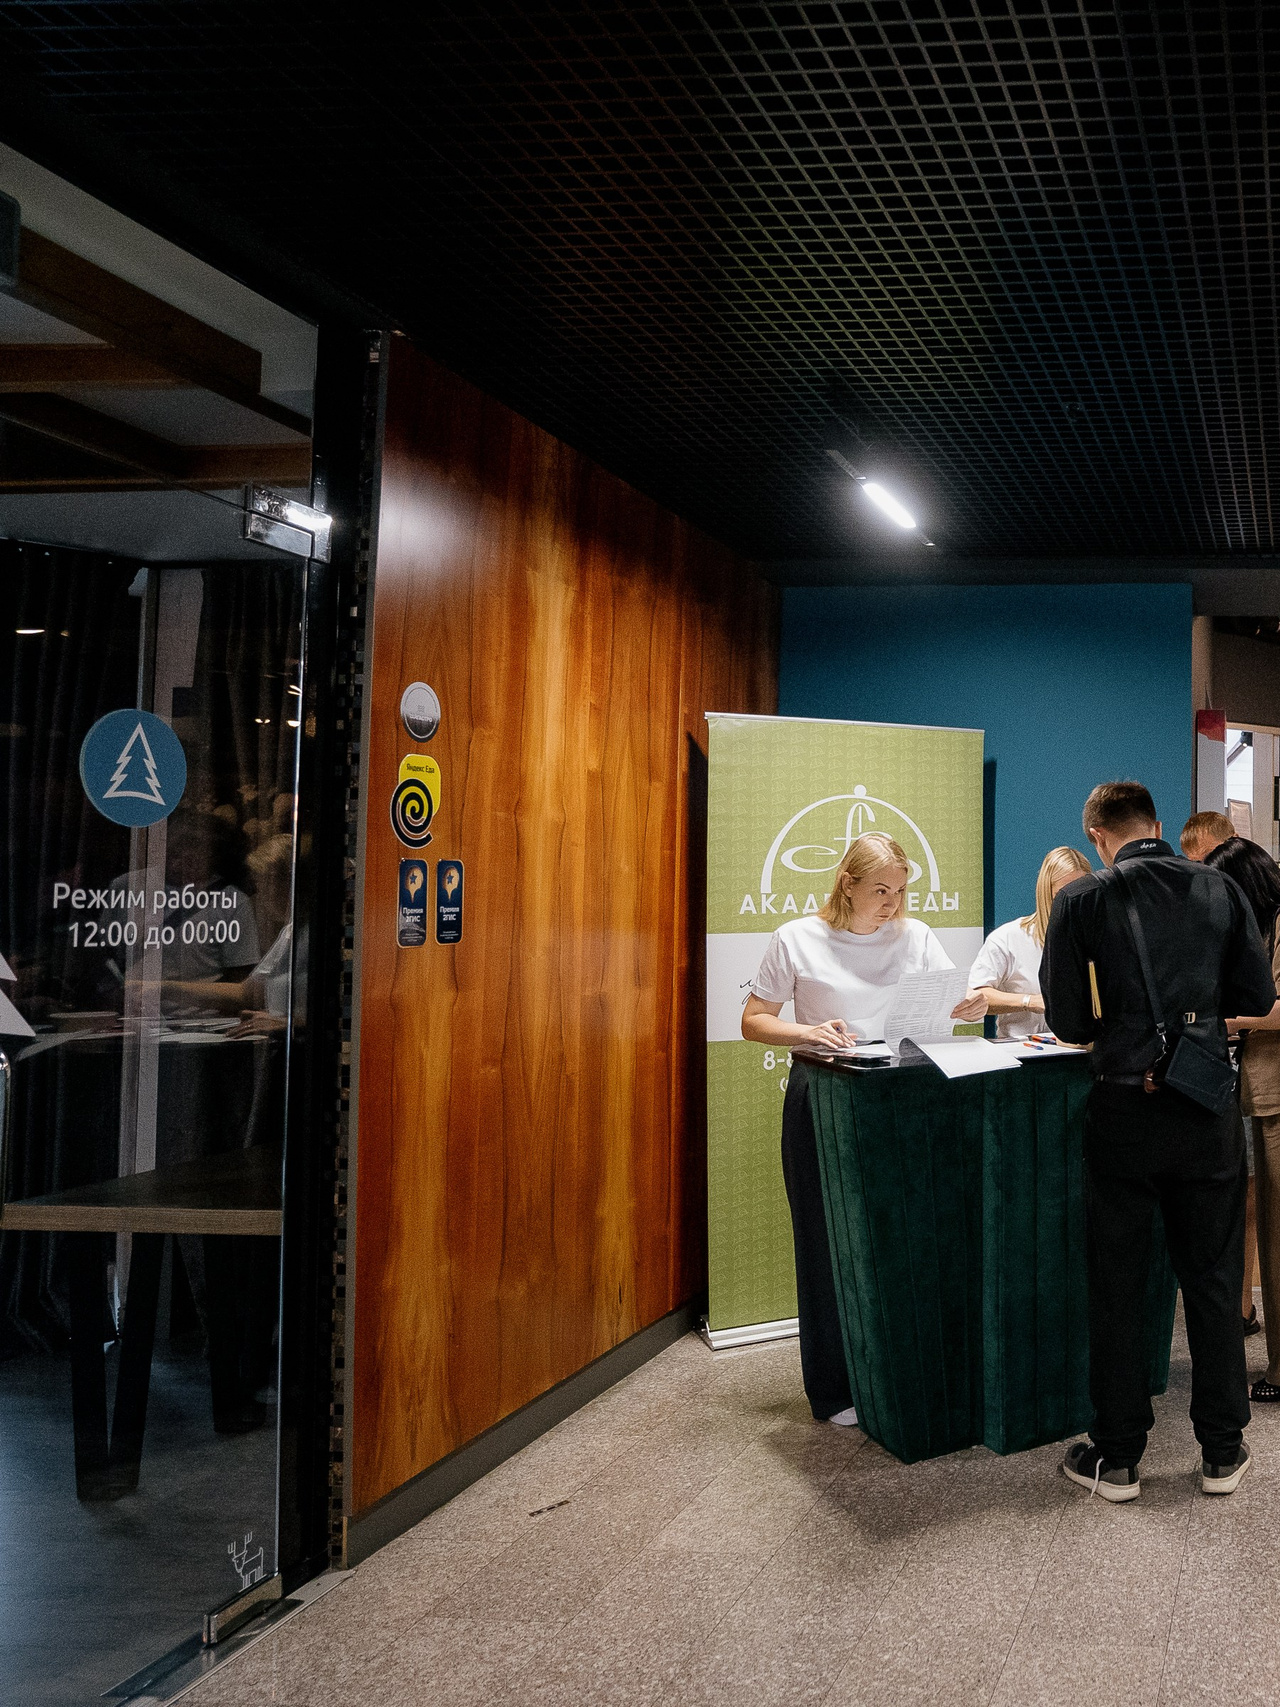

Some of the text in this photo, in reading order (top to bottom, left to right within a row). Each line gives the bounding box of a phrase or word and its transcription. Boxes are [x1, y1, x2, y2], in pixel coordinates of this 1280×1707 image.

[406, 763, 434, 774] Яндекс Еда
[52, 882, 237, 914] Режим работы
[402, 907, 424, 915] Премия
[440, 905, 460, 914] Премия
[405, 915, 421, 923] 2ГИС
[443, 913, 457, 921] 2ГИС
[69, 919, 240, 949] 12:00 до 00:00
